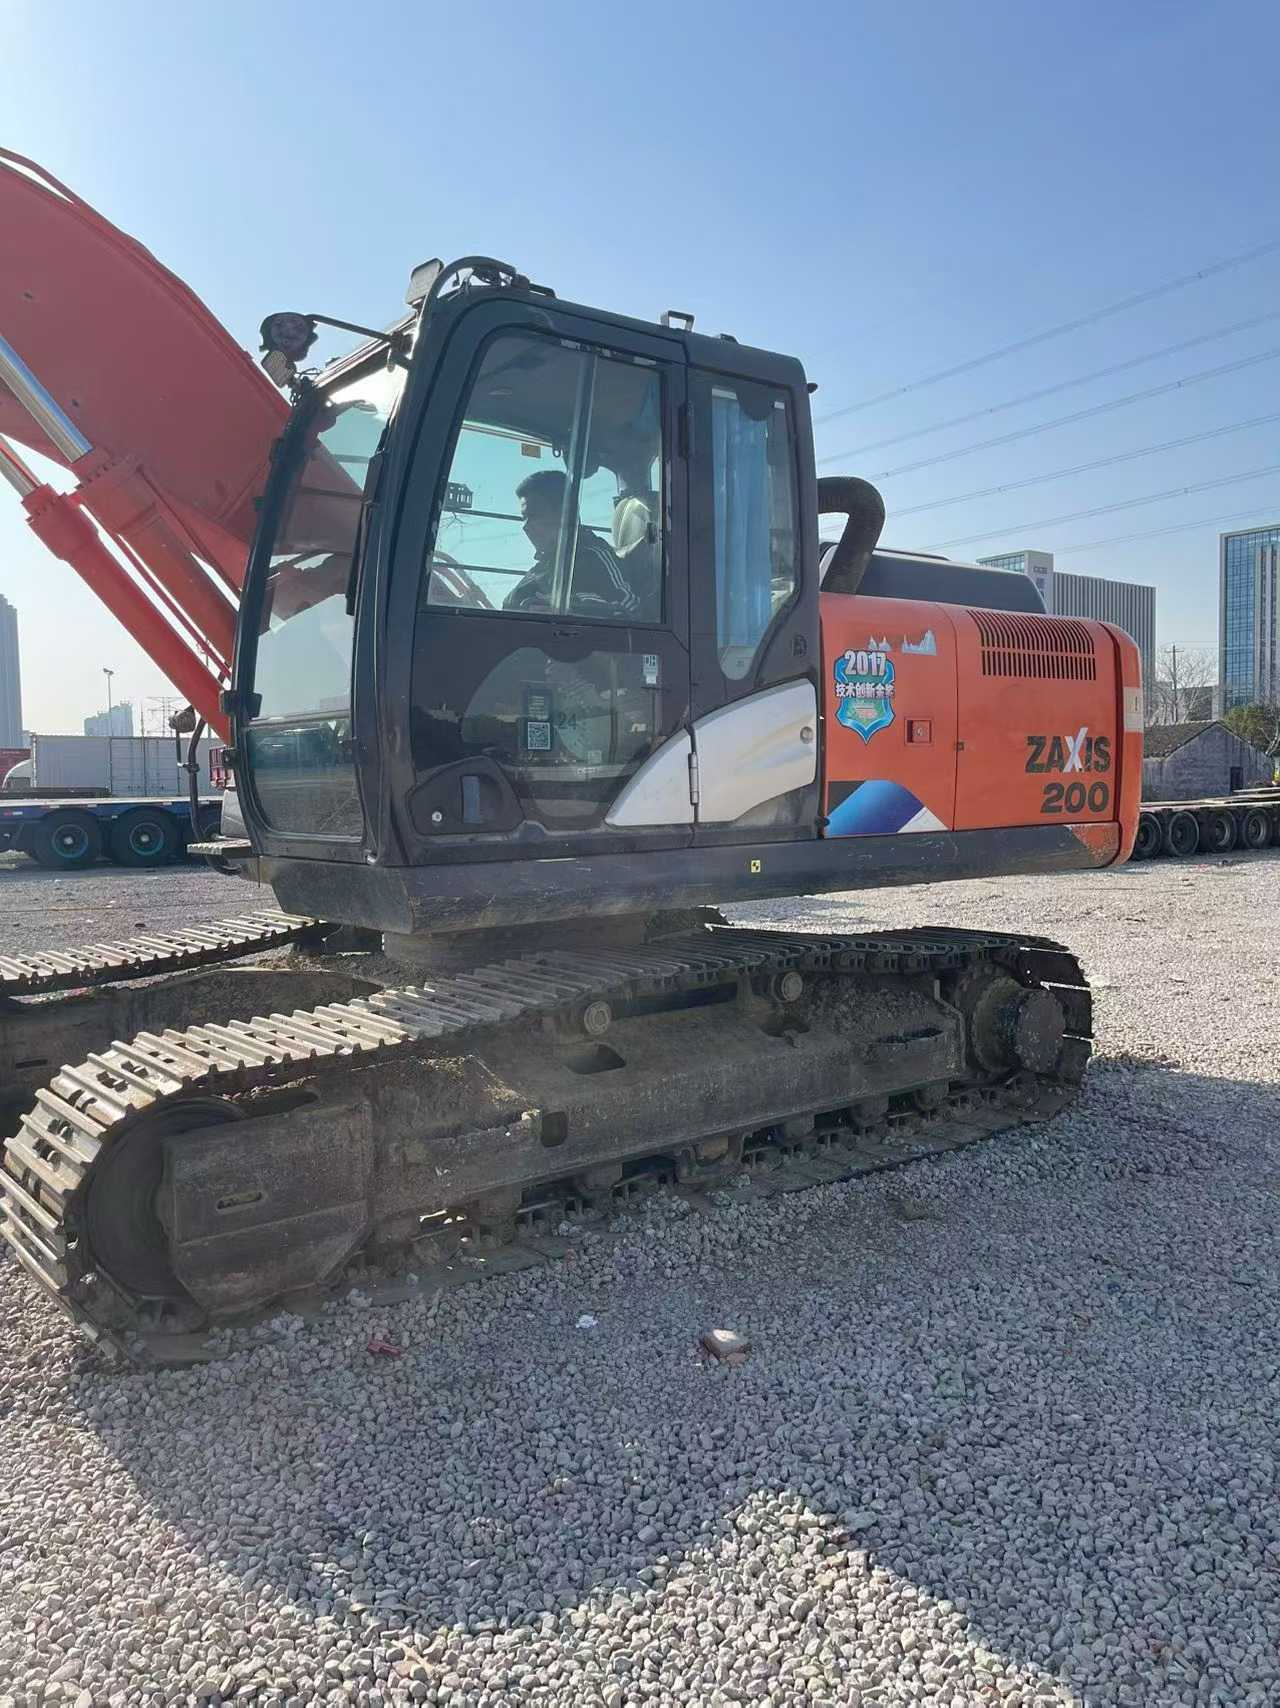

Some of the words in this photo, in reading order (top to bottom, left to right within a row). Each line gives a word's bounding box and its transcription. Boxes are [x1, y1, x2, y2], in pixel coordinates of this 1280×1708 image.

[844, 650, 887, 676] 2017
[1025, 727, 1110, 773] ZAXIS
[1040, 781, 1109, 814] 200
